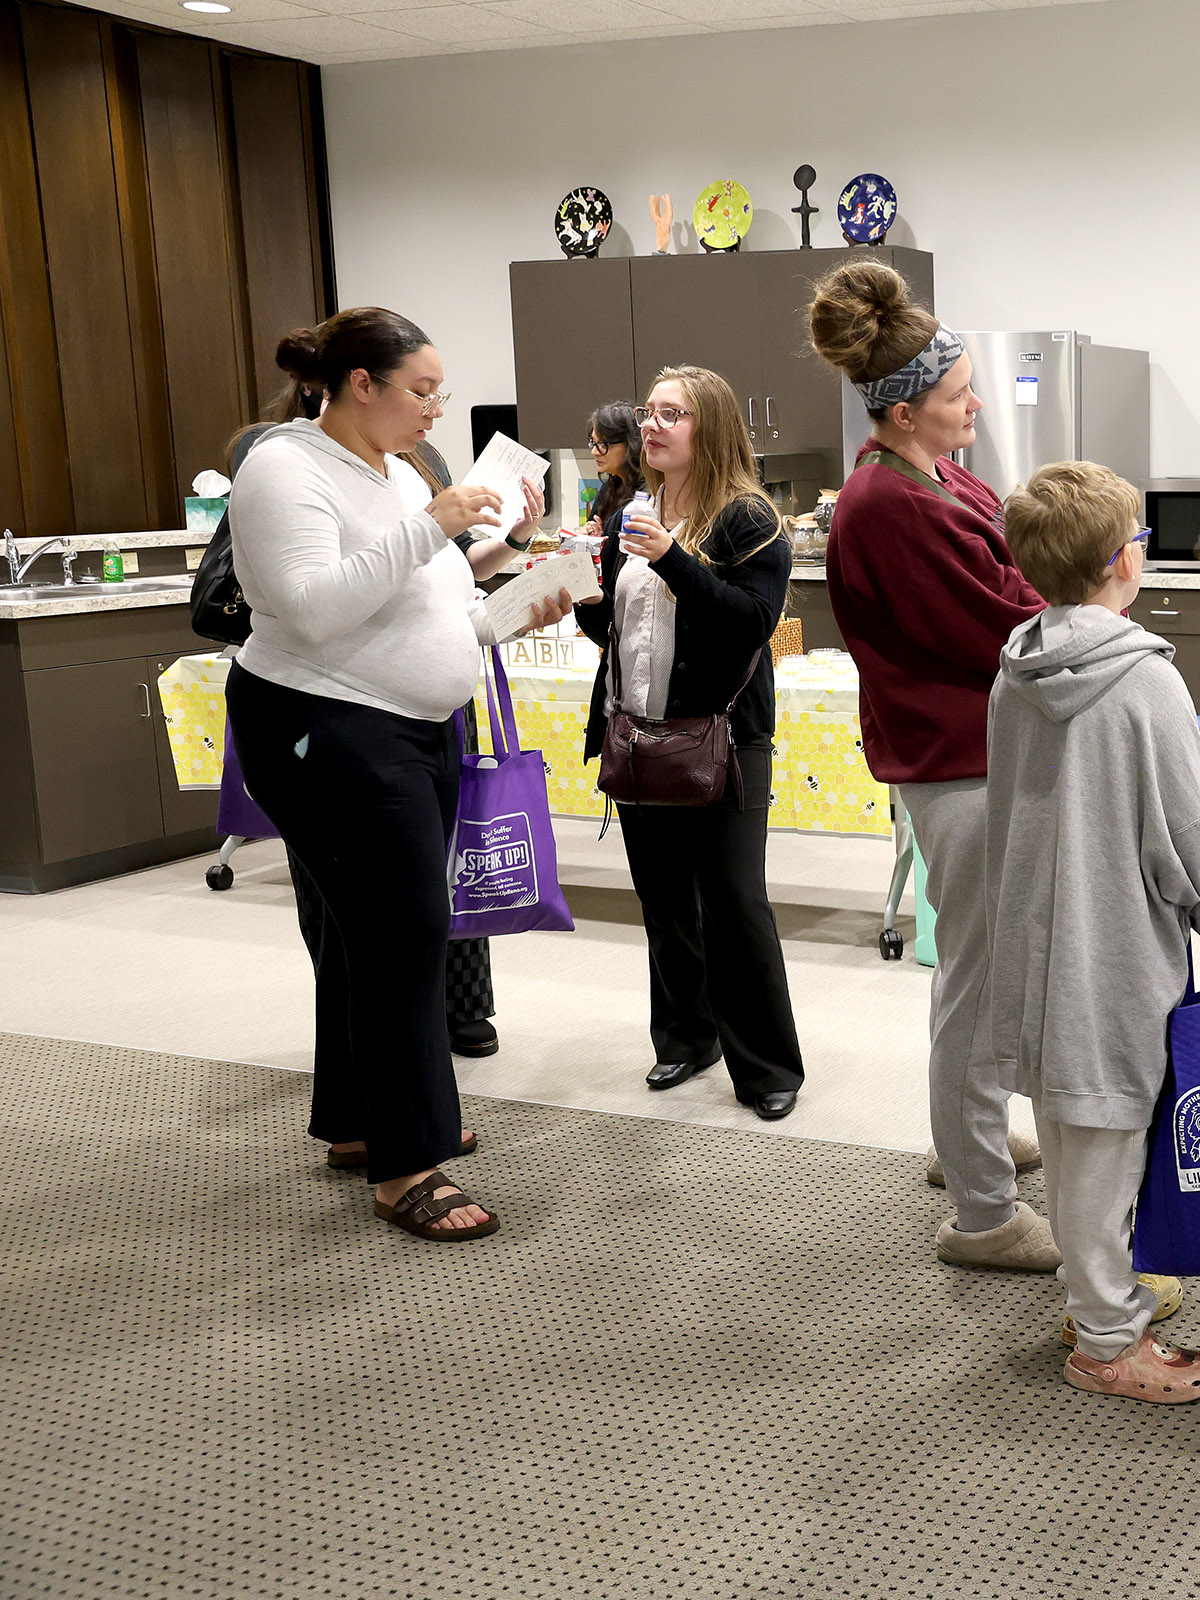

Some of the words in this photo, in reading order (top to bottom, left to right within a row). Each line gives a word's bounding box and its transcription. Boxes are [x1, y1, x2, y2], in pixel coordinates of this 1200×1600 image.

[487, 642, 569, 666] ABY
[468, 851, 503, 871] SPEAK
[504, 846, 525, 866] UP!
[1179, 1115, 1187, 1154] EXPECTING
